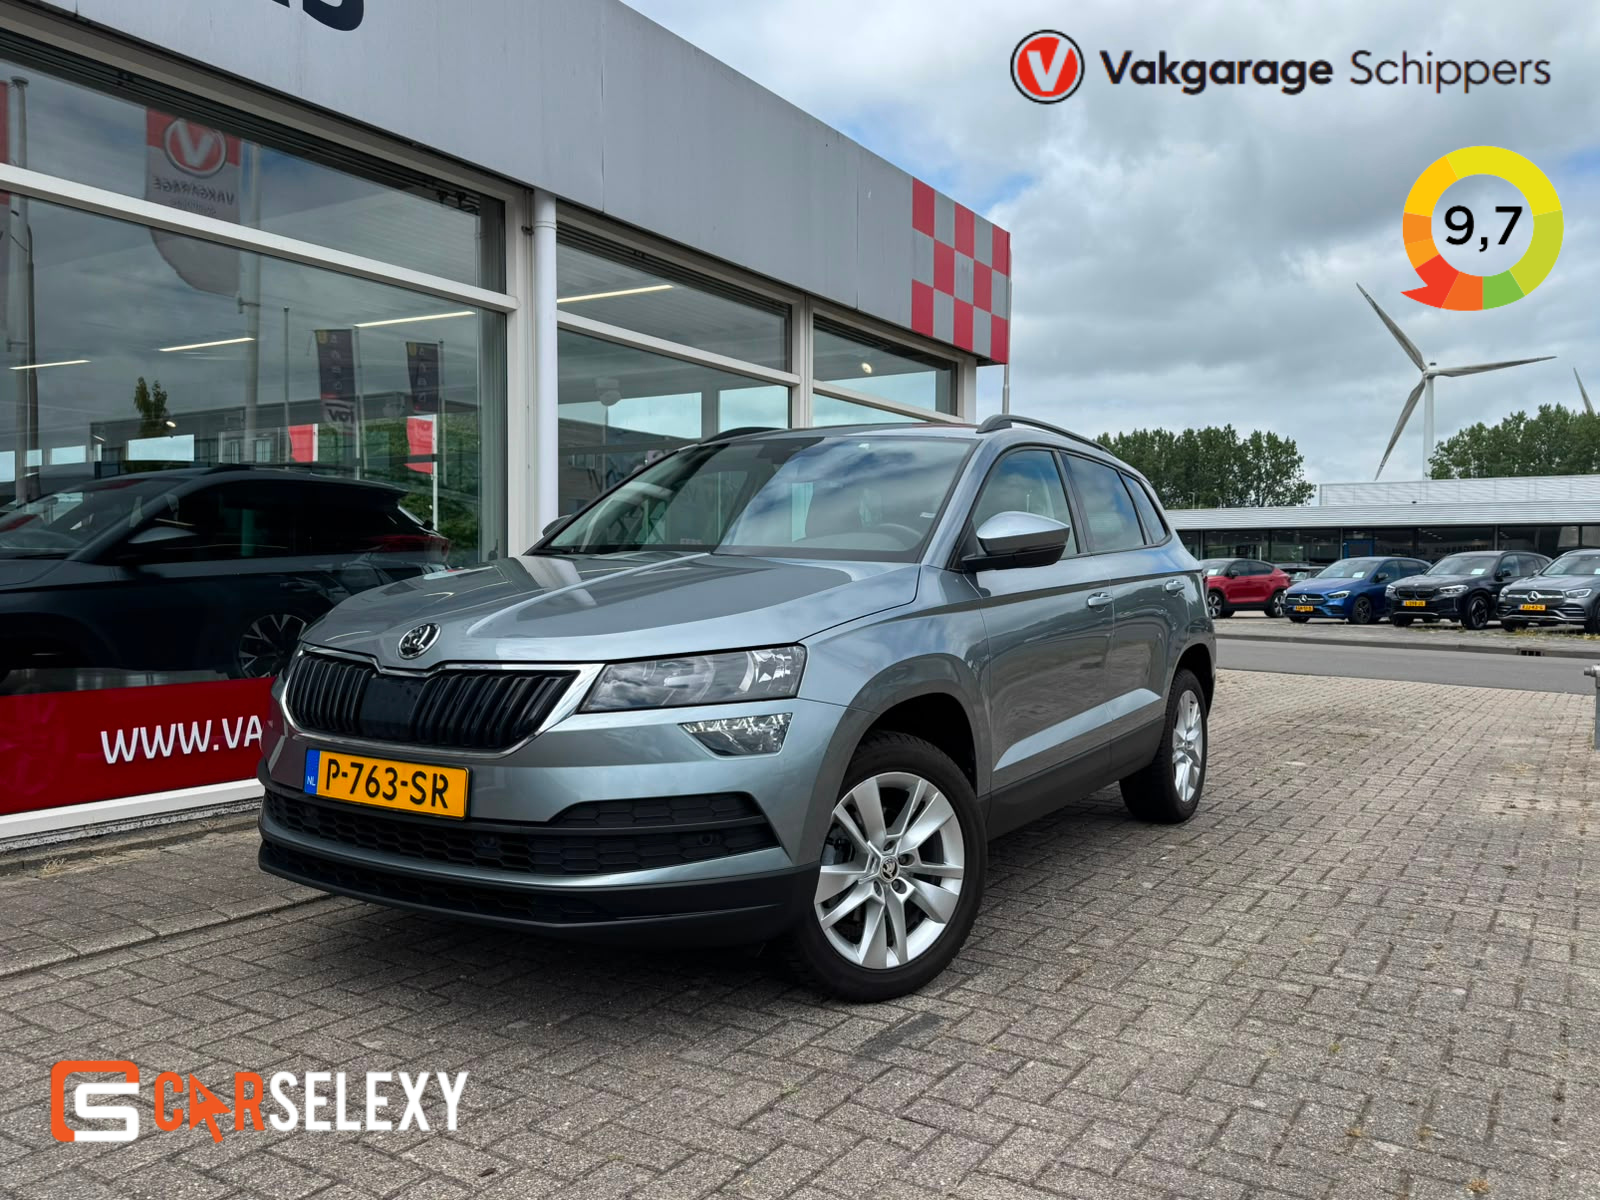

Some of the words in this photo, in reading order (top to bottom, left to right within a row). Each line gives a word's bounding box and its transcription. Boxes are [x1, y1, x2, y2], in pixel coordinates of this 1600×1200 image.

[101, 715, 263, 764] WWW.VA
[307, 775, 316, 786] NL
[326, 758, 449, 809] P-763-SR
